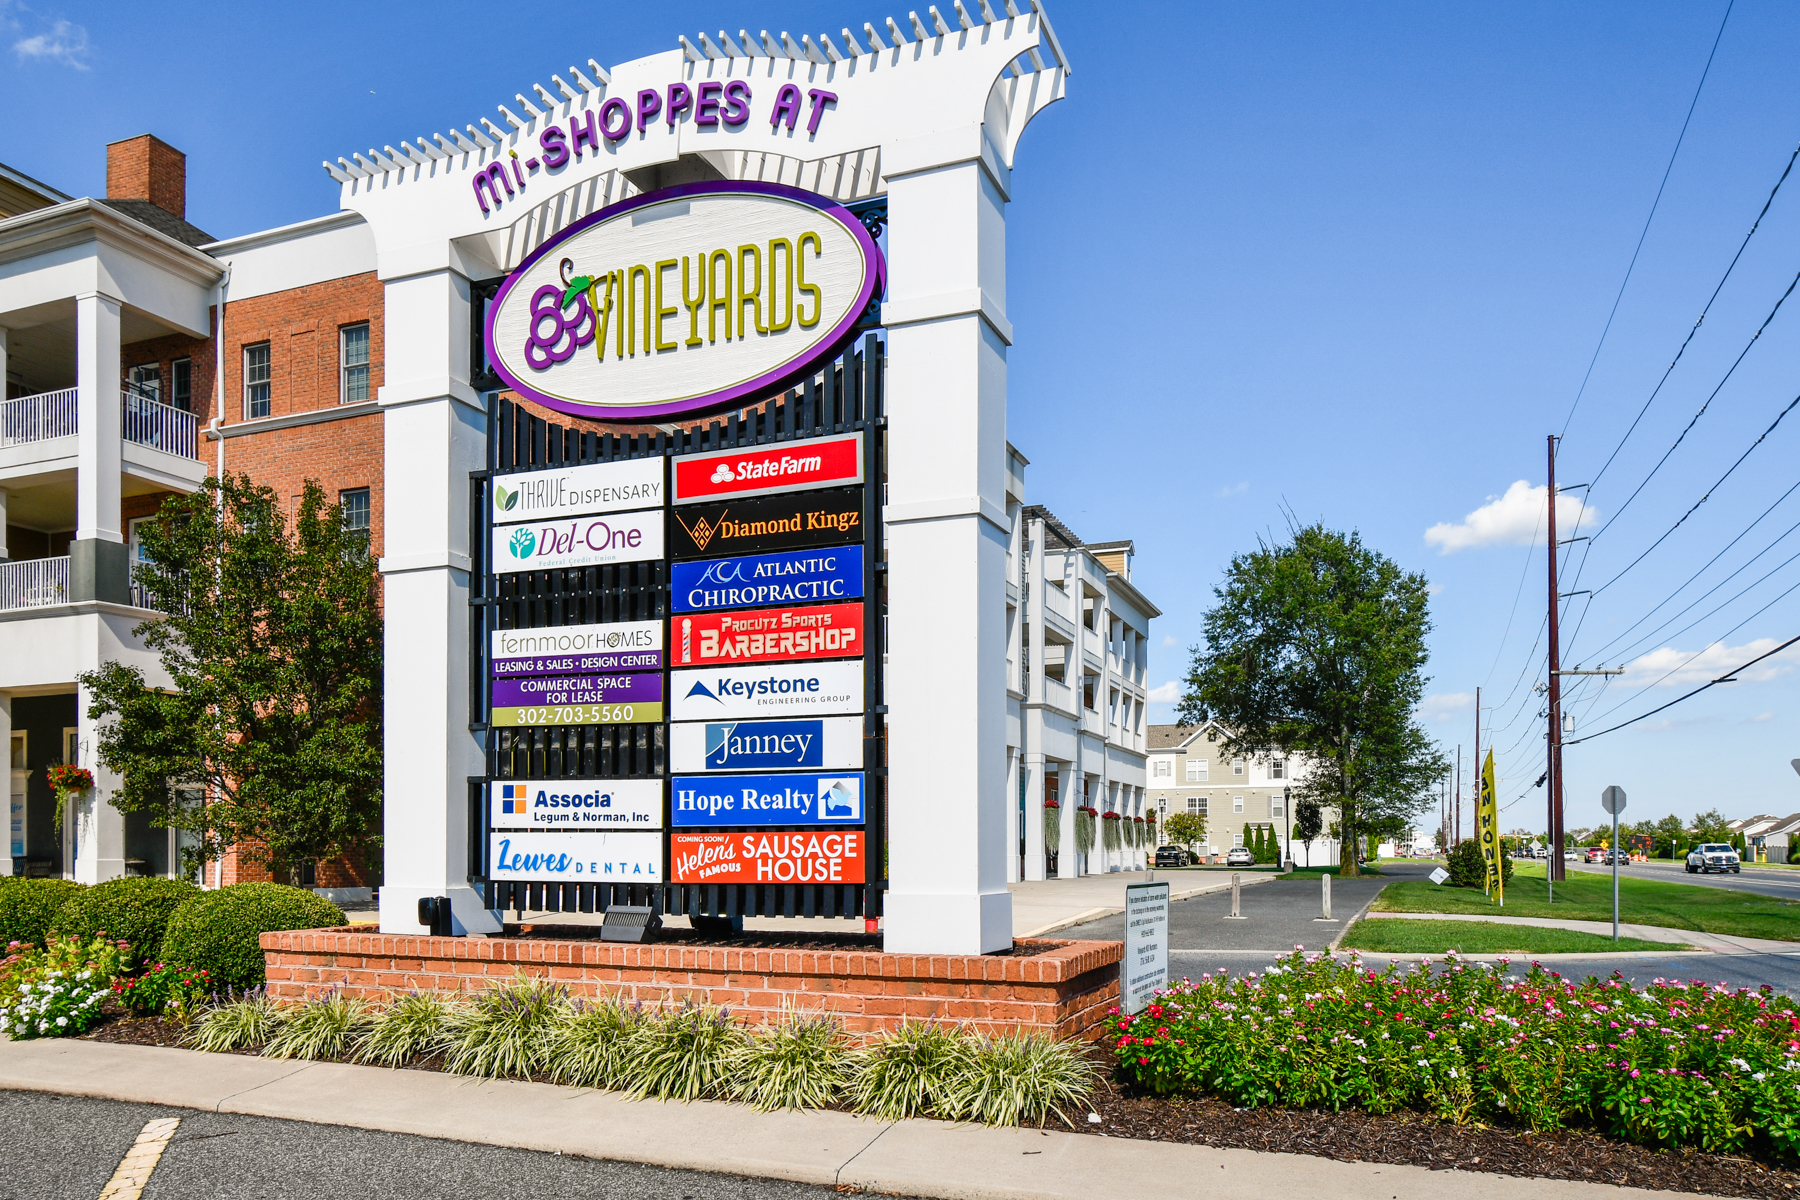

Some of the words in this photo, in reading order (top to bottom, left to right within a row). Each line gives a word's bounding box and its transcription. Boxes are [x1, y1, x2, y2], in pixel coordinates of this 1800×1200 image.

[769, 83, 839, 135] AT
[588, 231, 821, 361] VINEYARDS
[519, 477, 567, 511] THRIVE
[569, 482, 660, 506] DISPENSARY
[721, 512, 802, 539] Diamond
[806, 510, 859, 531] Kingz
[536, 521, 642, 556] Del-One
[538, 558, 566, 567] Federal
[568, 556, 592, 565] Credit
[753, 557, 836, 578] ATLANTIC
[688, 579, 844, 608] CHIROPRACTIC
[721, 616, 778, 633] PROCUTZ
[781, 612, 832, 629] SPORTS
[596, 630, 653, 648] HOMES
[699, 627, 856, 659] BARBERSHOP
[495, 660, 534, 673] LEASING
[536, 660, 544, 671] &
[546, 658, 573, 670] SALES
[582, 656, 618, 669] DESIGN
[622, 654, 658, 667] CENTER
[520, 678, 593, 692] COMMERCIAL
[597, 676, 632, 689] SPACE
[718, 676, 820, 700] Keystone
[546, 692, 568, 704] FOR
[571, 691, 603, 703] LEASE
[757, 696, 816, 706] ENGINEERING
[820, 694, 851, 704] GROUP
[516, 705, 634, 724] 302-703-5560
[716, 727, 813, 765] Janney
[534, 790, 611, 807] Associa
[677, 790, 735, 816] Hope
[741, 788, 814, 815] Realty
[534, 812, 569, 824] Legum
[572, 812, 580, 822] &
[583, 812, 630, 823] Norman,
[632, 812, 650, 822] Inc
[497, 839, 573, 872] Lewes
[576, 862, 656, 874] DENTAL
[676, 836, 737, 880] Helen's
[742, 834, 857, 859] SAUSAGE
[698, 862, 742, 879] FAMOUS
[757, 858, 842, 881] HOUSE
